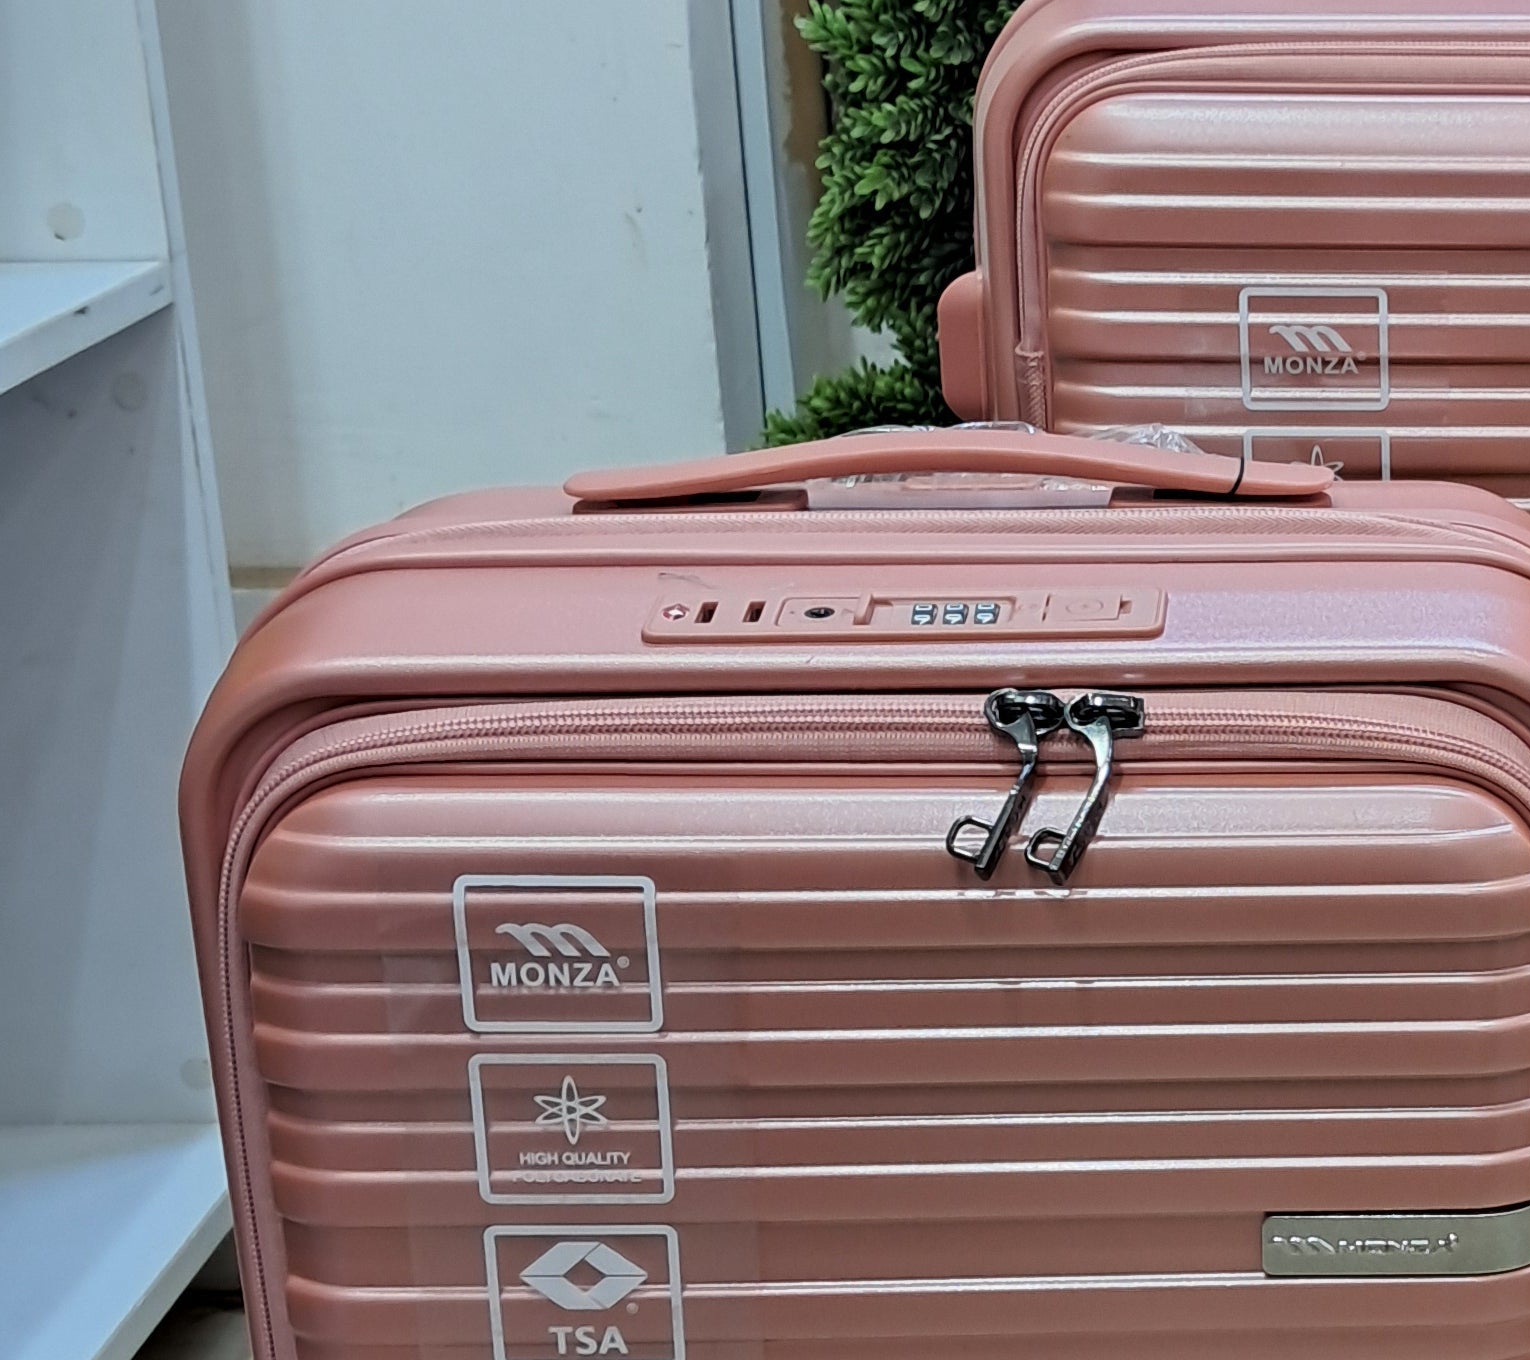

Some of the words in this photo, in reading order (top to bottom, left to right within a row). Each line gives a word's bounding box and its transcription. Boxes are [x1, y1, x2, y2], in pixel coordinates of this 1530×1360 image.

[1263, 356, 1360, 375] MONZA
[490, 961, 621, 987] MONZA
[518, 1151, 558, 1166] HIGH
[561, 1151, 631, 1167] QUALITY
[548, 1326, 629, 1355] TSA
